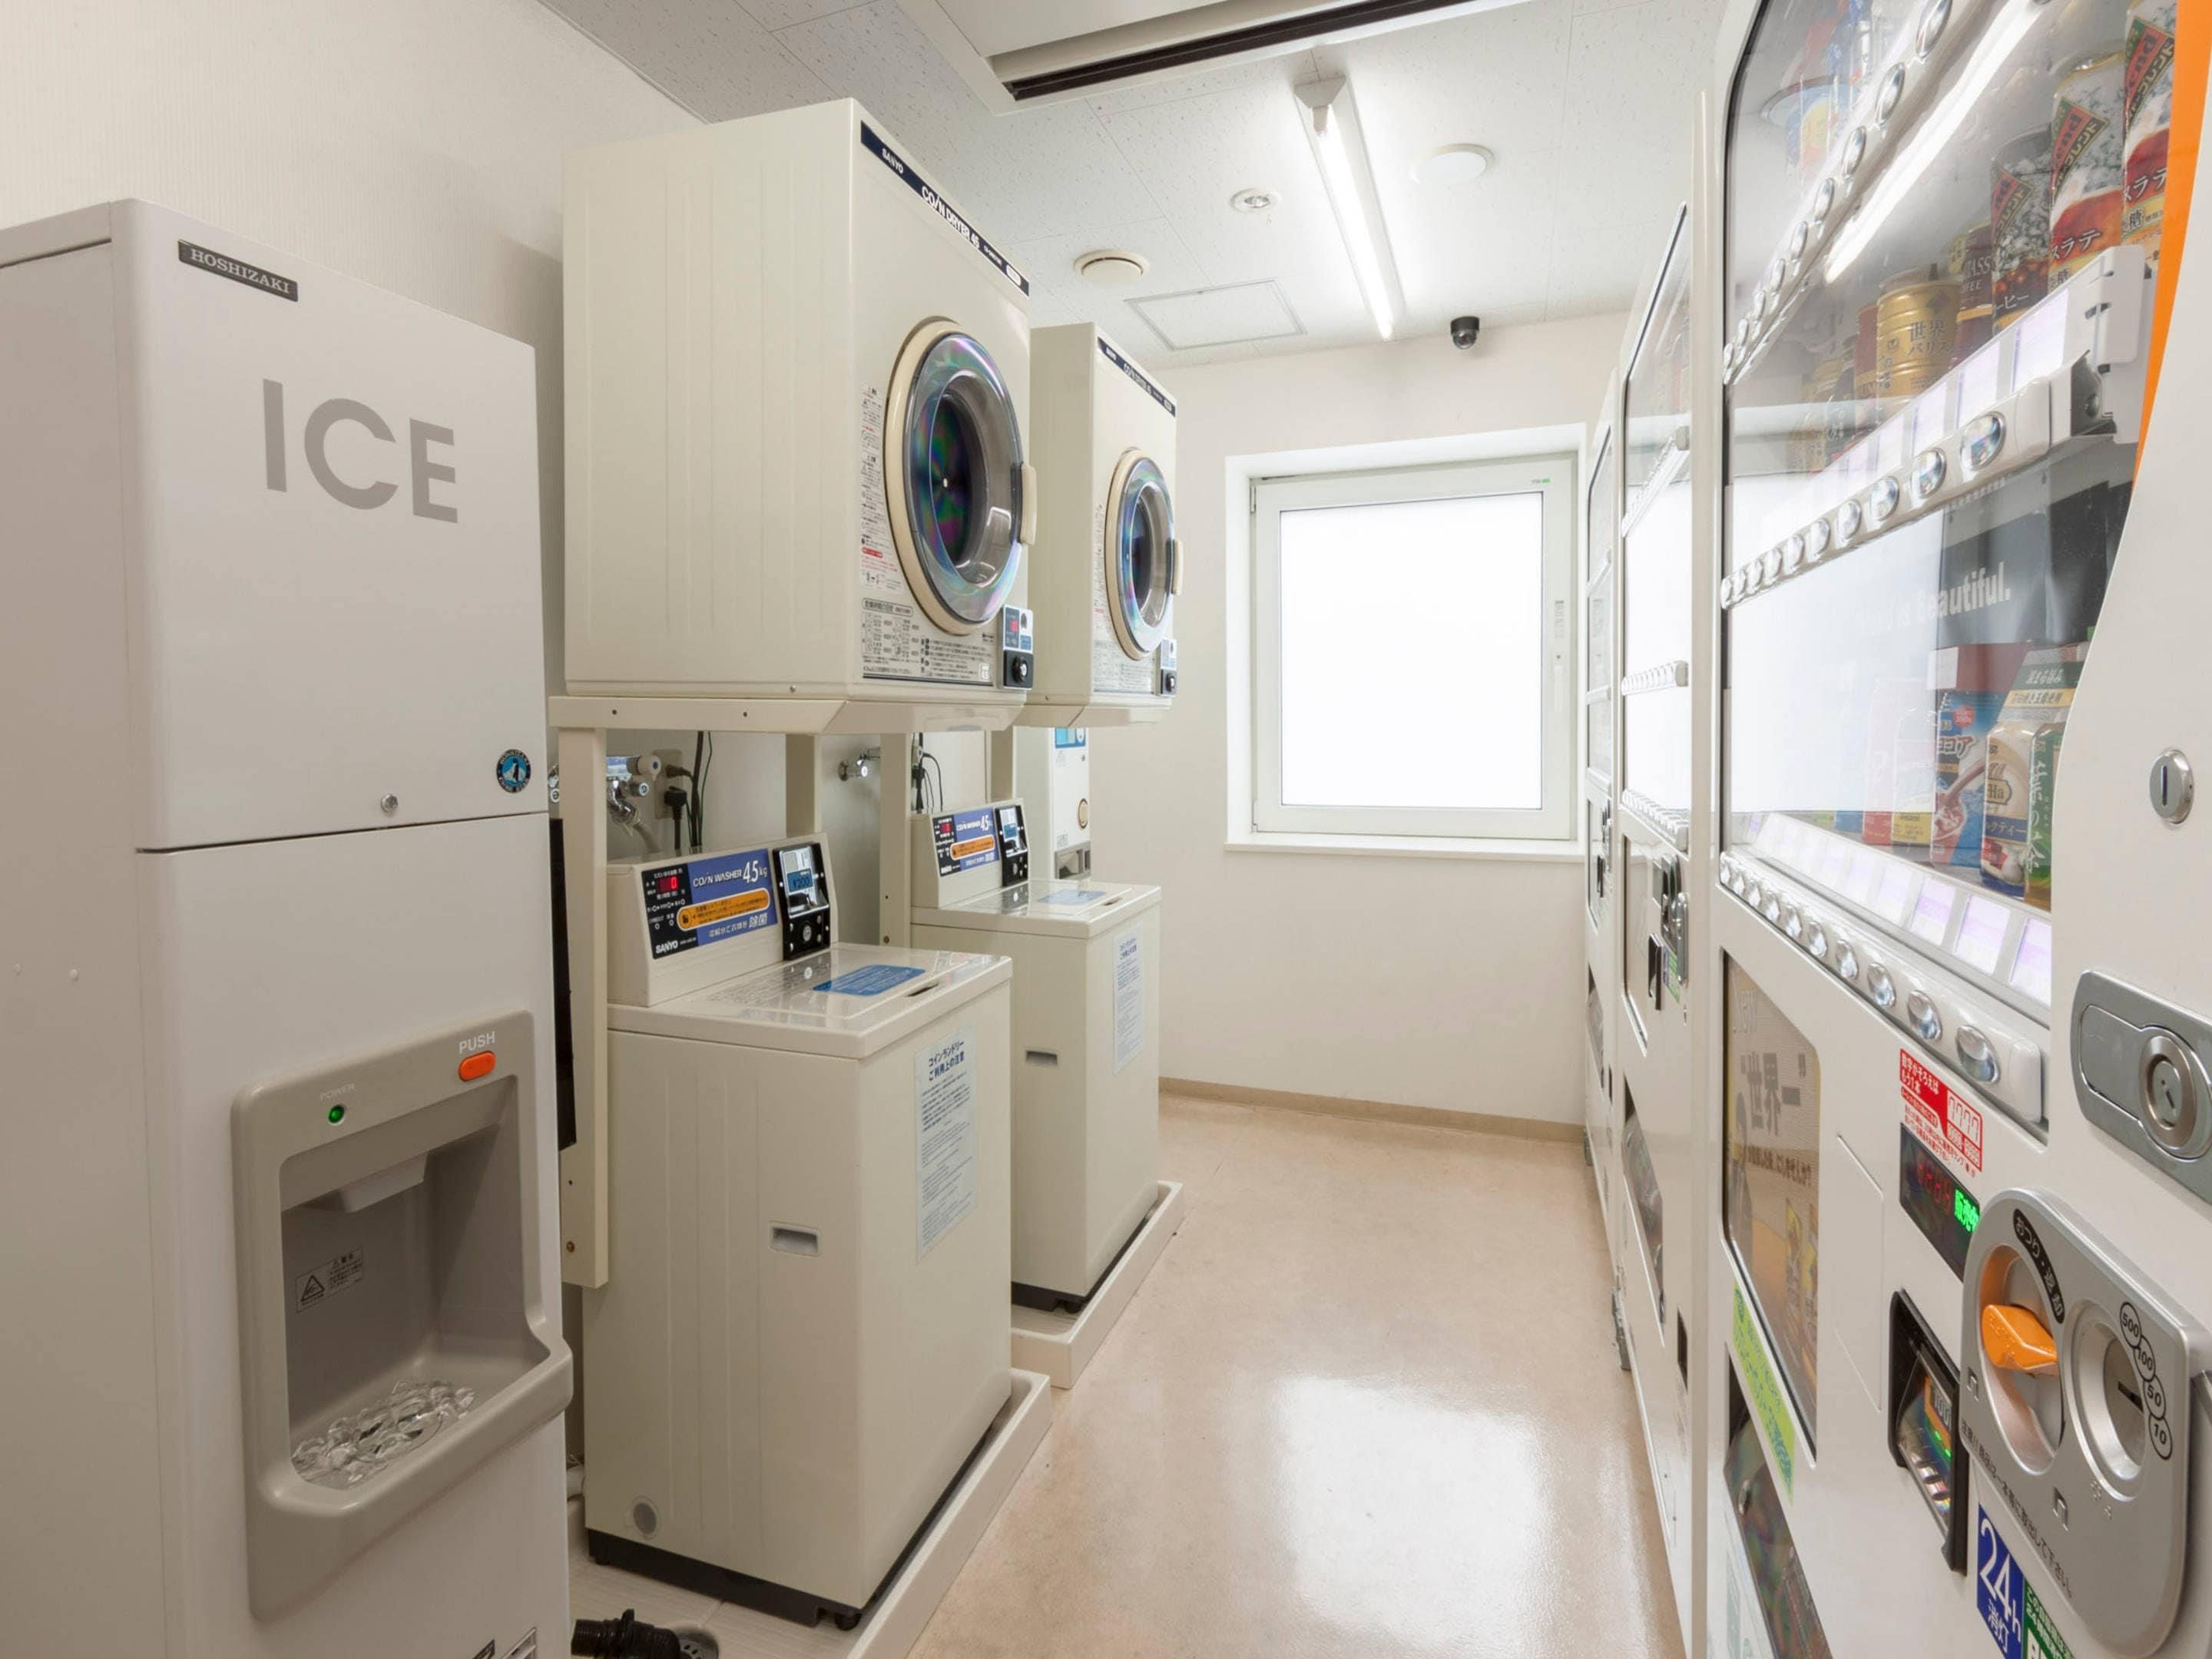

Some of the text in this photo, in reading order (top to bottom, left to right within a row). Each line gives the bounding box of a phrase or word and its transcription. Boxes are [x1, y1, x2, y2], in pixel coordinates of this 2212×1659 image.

[882, 148, 903, 174] SANYO
[946, 207, 970, 240] DRYER
[190, 248, 290, 294] HOSHIZAKI
[262, 378, 459, 524] ICE
[671, 876, 678, 889] 0
[714, 869, 742, 882] WASHER
[655, 940, 678, 954] SANYO
[459, 1031, 496, 1054] PUSH
[320, 1082, 356, 1101] POWER
[2122, 1313, 2140, 1338] 500
[2137, 1346, 2153, 1371] 100
[2147, 1384, 2162, 1407] 50
[2154, 1422, 2167, 1445] 10
